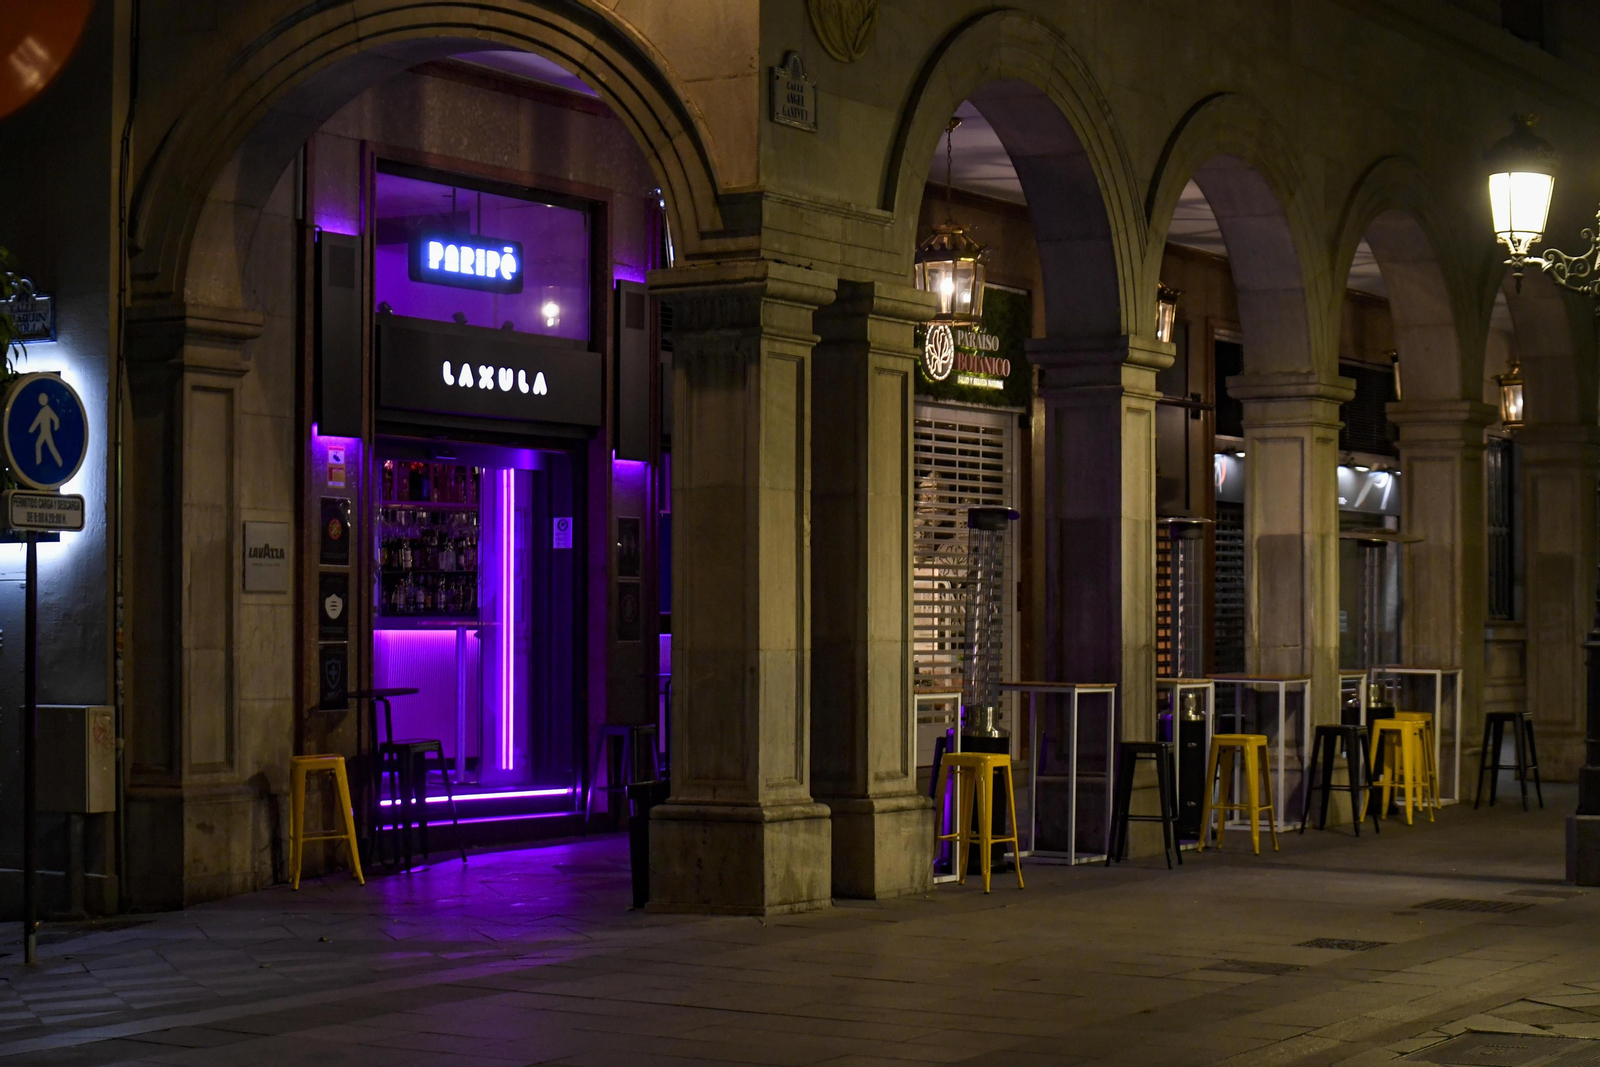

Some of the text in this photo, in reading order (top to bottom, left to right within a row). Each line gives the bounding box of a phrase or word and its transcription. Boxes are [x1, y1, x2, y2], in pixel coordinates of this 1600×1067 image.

[786, 81, 803, 92] CALLE
[10, 303, 37, 313] CALLE
[957, 327, 1000, 352] PARAÍSO
[957, 352, 1011, 377] BOTÁNICO
[442, 360, 548, 396] LAXULA
